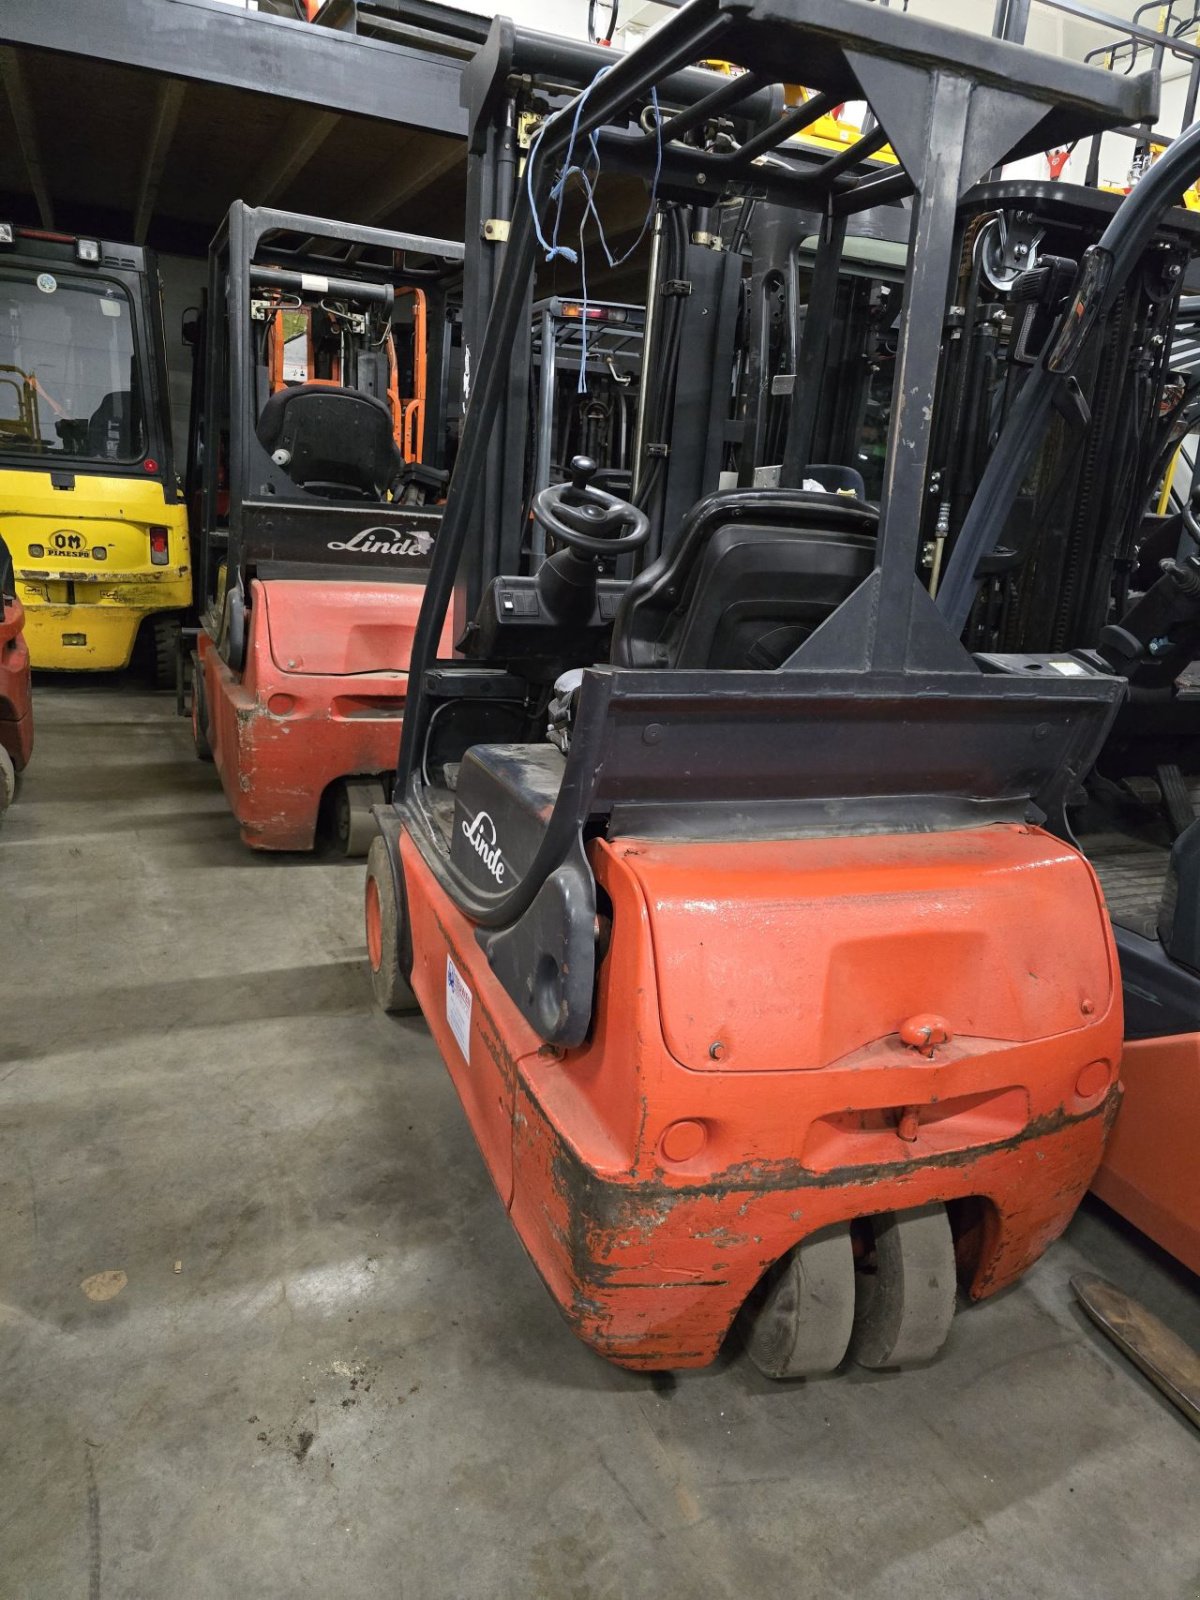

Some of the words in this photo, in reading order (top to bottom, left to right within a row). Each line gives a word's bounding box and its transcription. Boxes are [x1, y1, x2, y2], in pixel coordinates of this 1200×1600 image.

[55, 534, 81, 549] OM
[327, 526, 421, 556] Linde
[48, 550, 90, 558] PIMESPO
[462, 811, 504, 884] Linde
